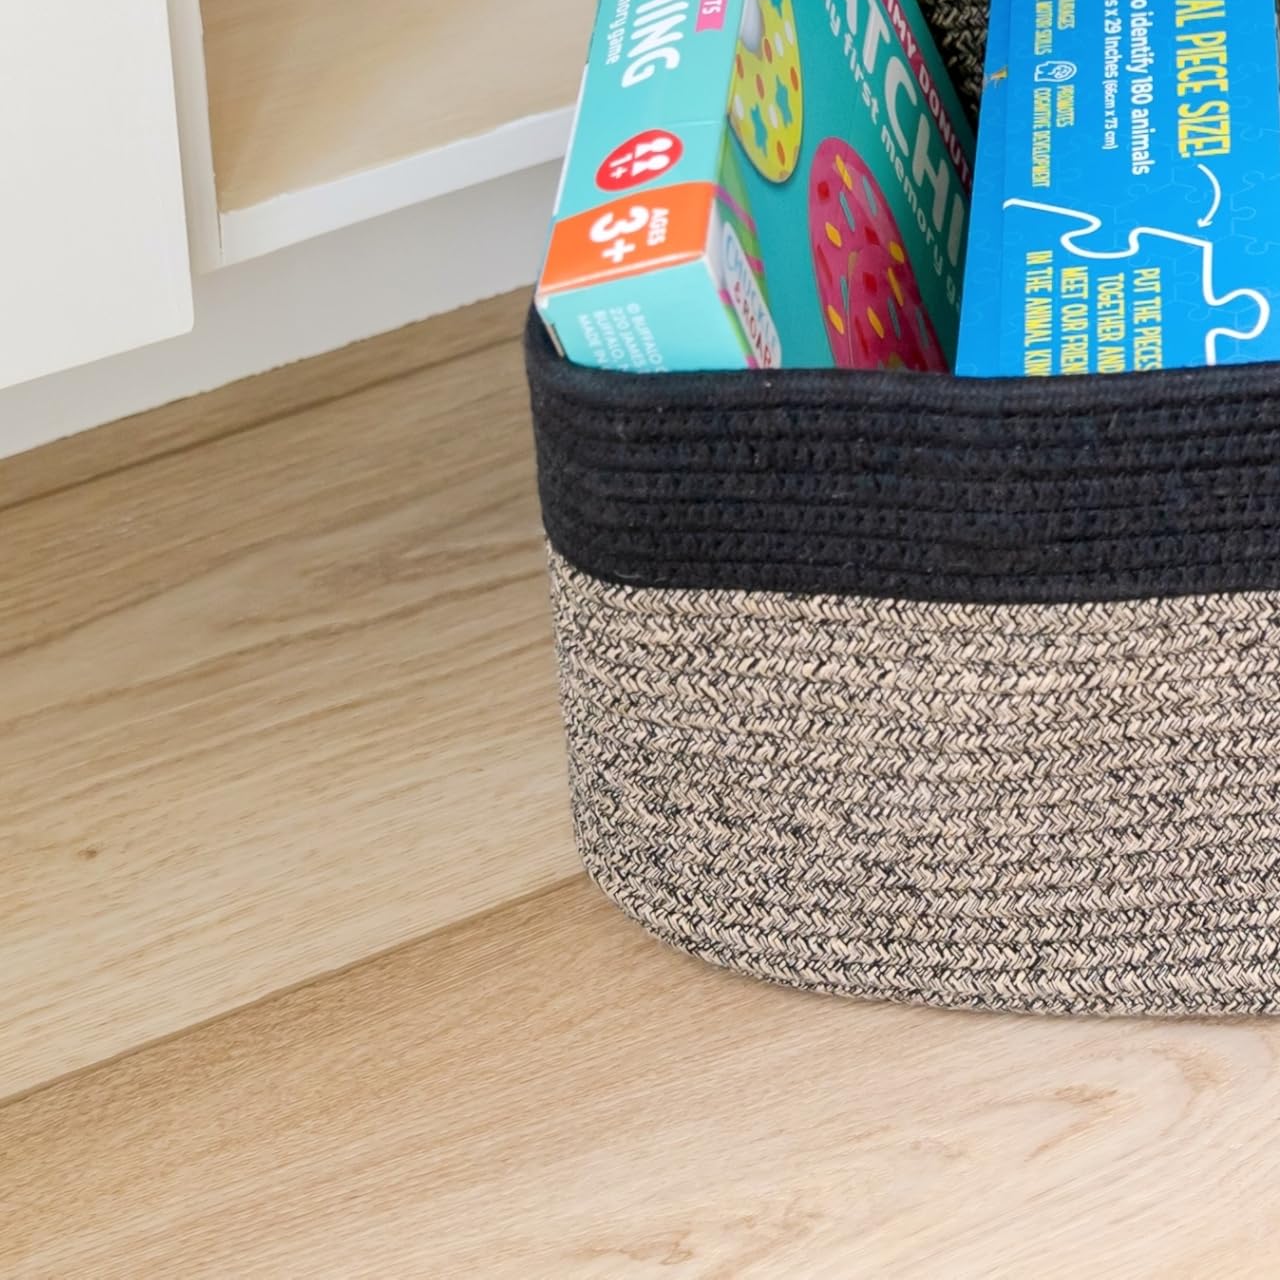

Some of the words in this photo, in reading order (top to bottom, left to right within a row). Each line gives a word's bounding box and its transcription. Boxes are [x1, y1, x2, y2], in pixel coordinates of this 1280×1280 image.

[1104, 8, 1119, 18] x
[1104, 18, 1121, 35] 29
[606, 26, 624, 65] game
[1104, 36, 1122, 79] Inches
[1126, 11, 1155, 74] identify
[1175, 31, 1229, 97] PIECE
[1102, 79, 1118, 109] (66cm
[1130, 75, 1154, 105] 180
[919, 62, 973, 187] DONUT
[1102, 131, 1119, 150] cm)
[1104, 117, 1118, 129] 73
[1177, 100, 1231, 158] SIZE!
[844, 32, 879, 125] first
[881, 124, 943, 276] memory
[1131, 107, 1156, 176] animals
[609, 153, 633, 179] 1+
[589, 206, 650, 264] 3+
[647, 207, 670, 246] AGES
[1026, 250, 1053, 265] IN
[1025, 266, 1053, 294] THE
[1061, 266, 1088, 299] MEET
[1133, 267, 1161, 293] PUT
[1024, 297, 1052, 347] ANIMAL
[1061, 303, 1088, 332] OUR
[1097, 272, 1125, 342] TOGETHER
[1133, 296, 1161, 325] THE
[578, 314, 601, 347] MADE
[632, 314, 663, 365] BUFFALO
[1060, 333, 1088, 375] FRIEN
[1097, 346, 1125, 374] AND
[1133, 326, 1162, 372] PIECES
